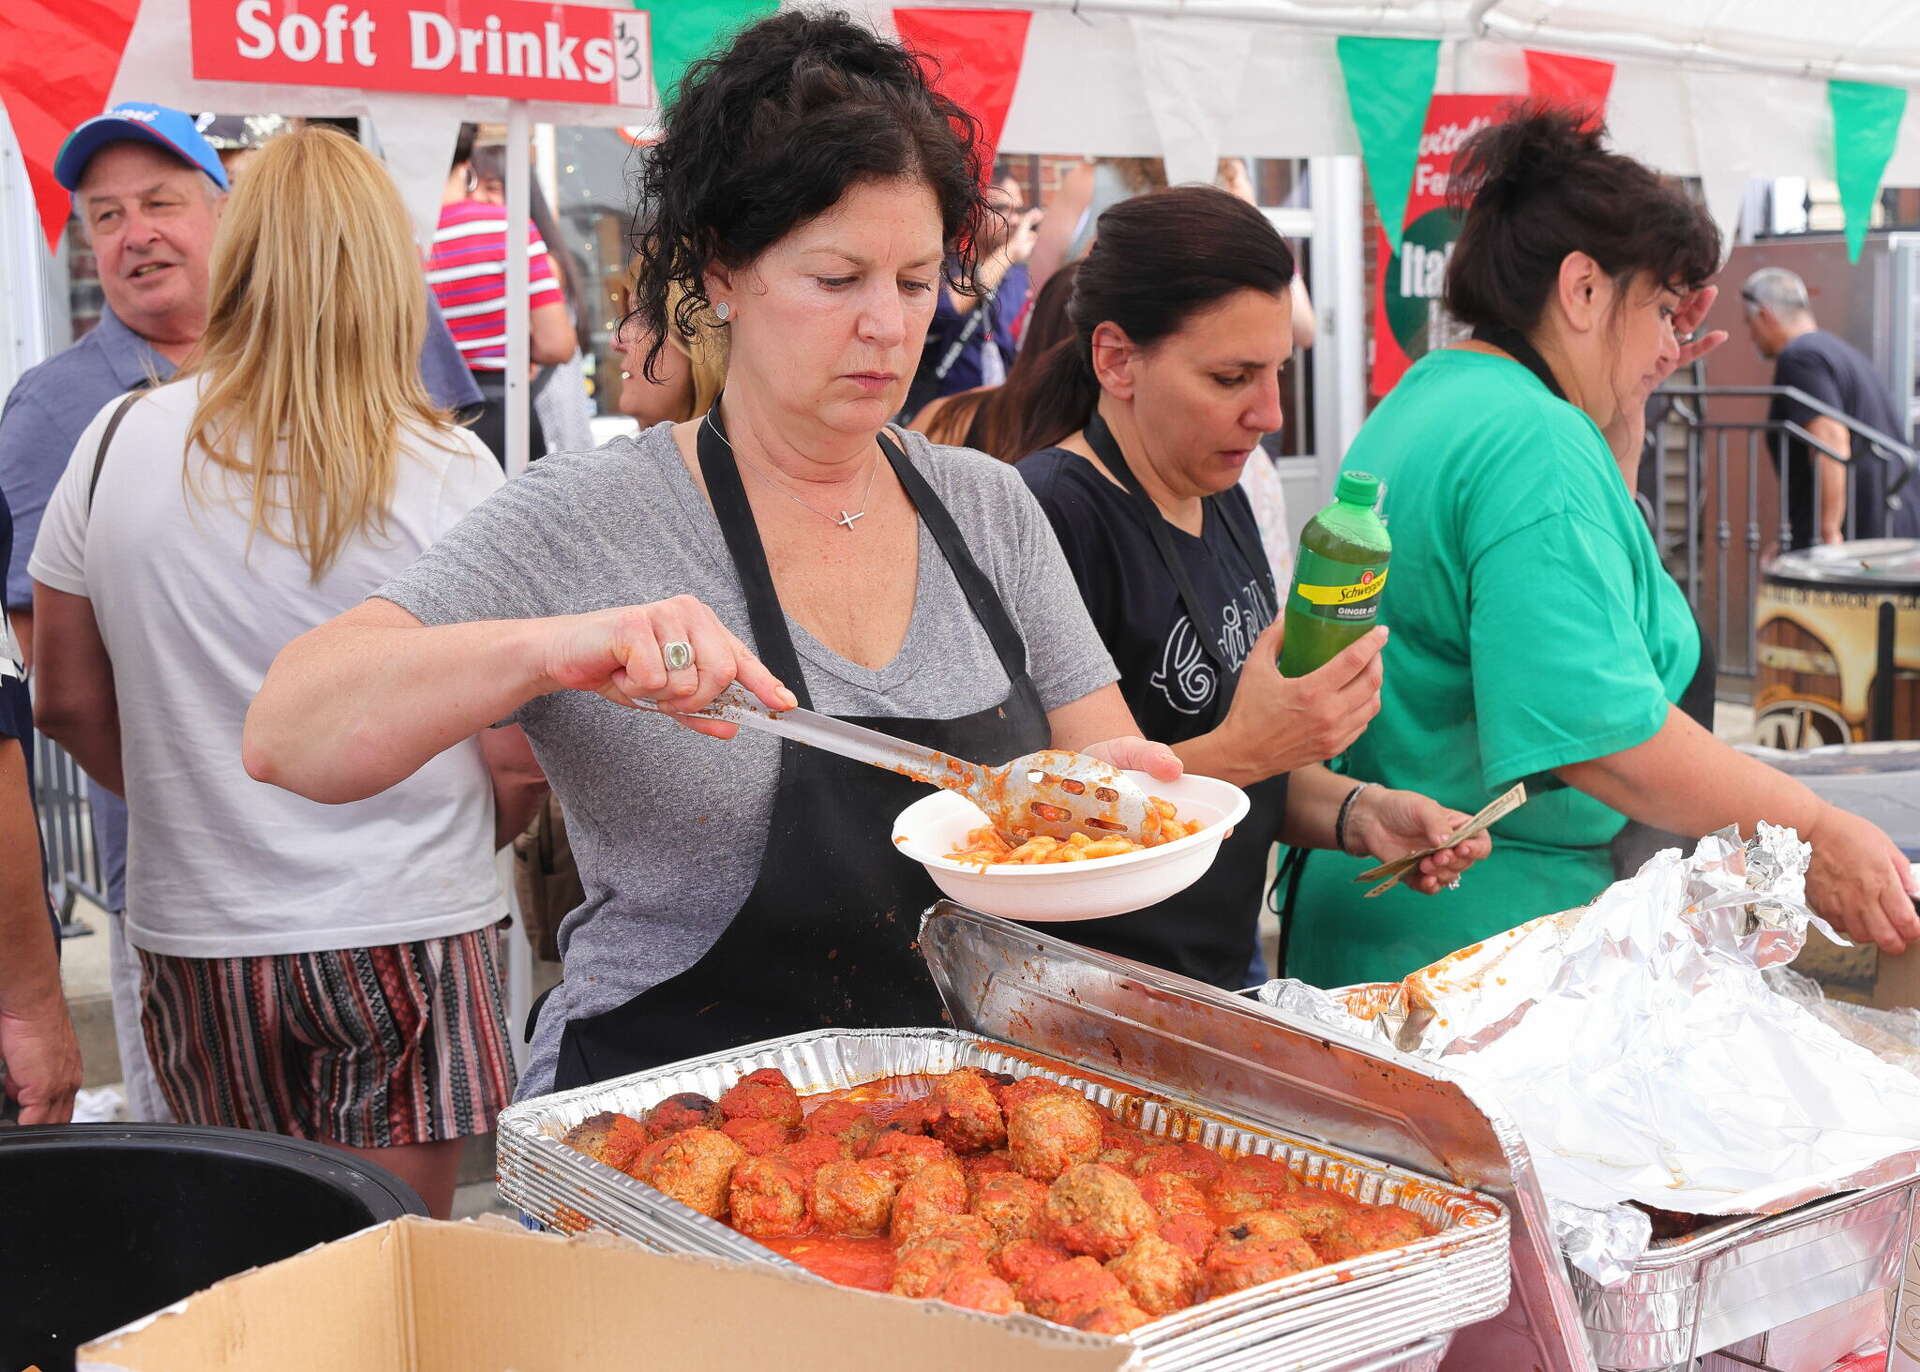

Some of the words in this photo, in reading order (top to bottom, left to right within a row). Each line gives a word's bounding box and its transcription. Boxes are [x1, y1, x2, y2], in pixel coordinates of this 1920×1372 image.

[236, 0, 377, 67] Soft
[408, 10, 615, 84] Drinks
[1337, 607, 1367, 616] GINGER
